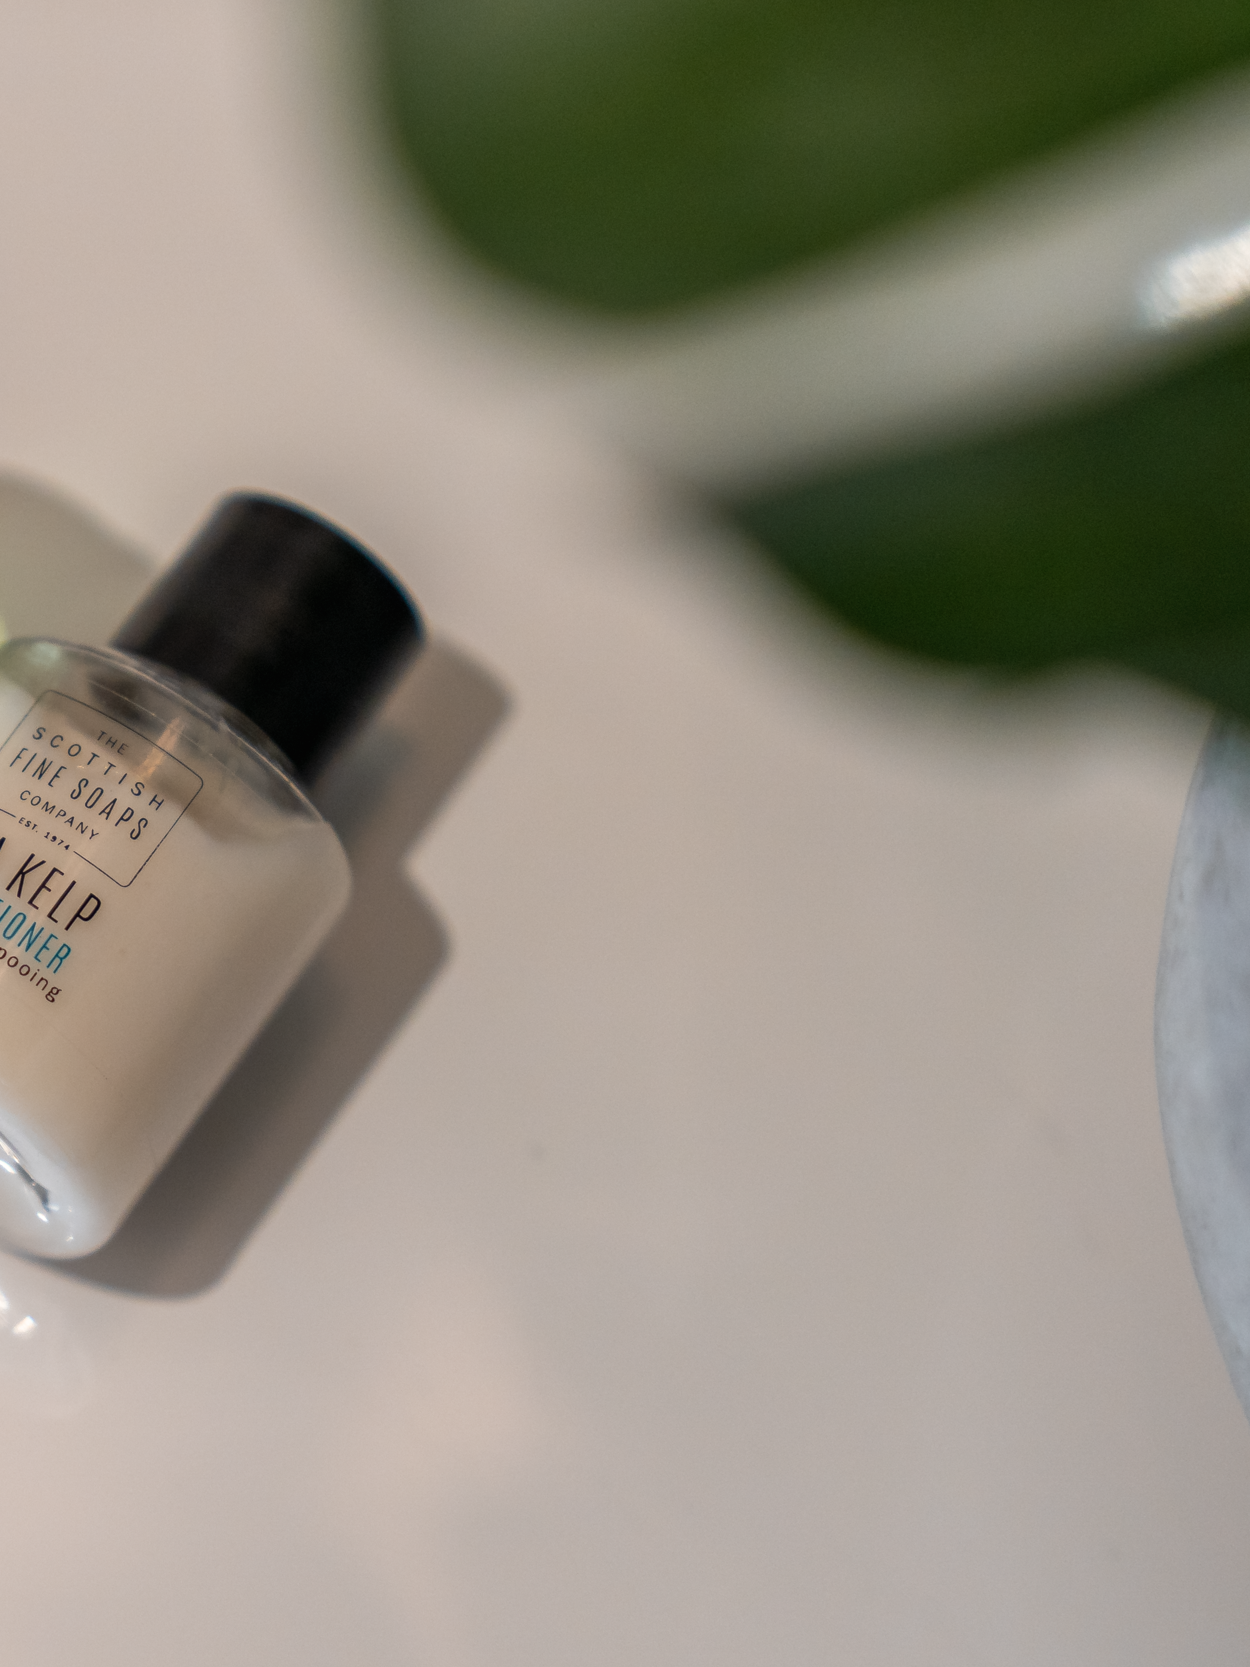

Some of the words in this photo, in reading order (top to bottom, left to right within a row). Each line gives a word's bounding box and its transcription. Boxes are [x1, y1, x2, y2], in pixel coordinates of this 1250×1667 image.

[32, 727, 164, 811] SCOTTISH
[97, 730, 129, 756] THE
[9, 748, 67, 788] FINE
[70, 778, 148, 840] SOAPS
[20, 790, 99, 840] COMPANY
[18, 817, 38, 832] EST.
[44, 832, 70, 850] 1974
[6, 853, 101, 931] KELP
